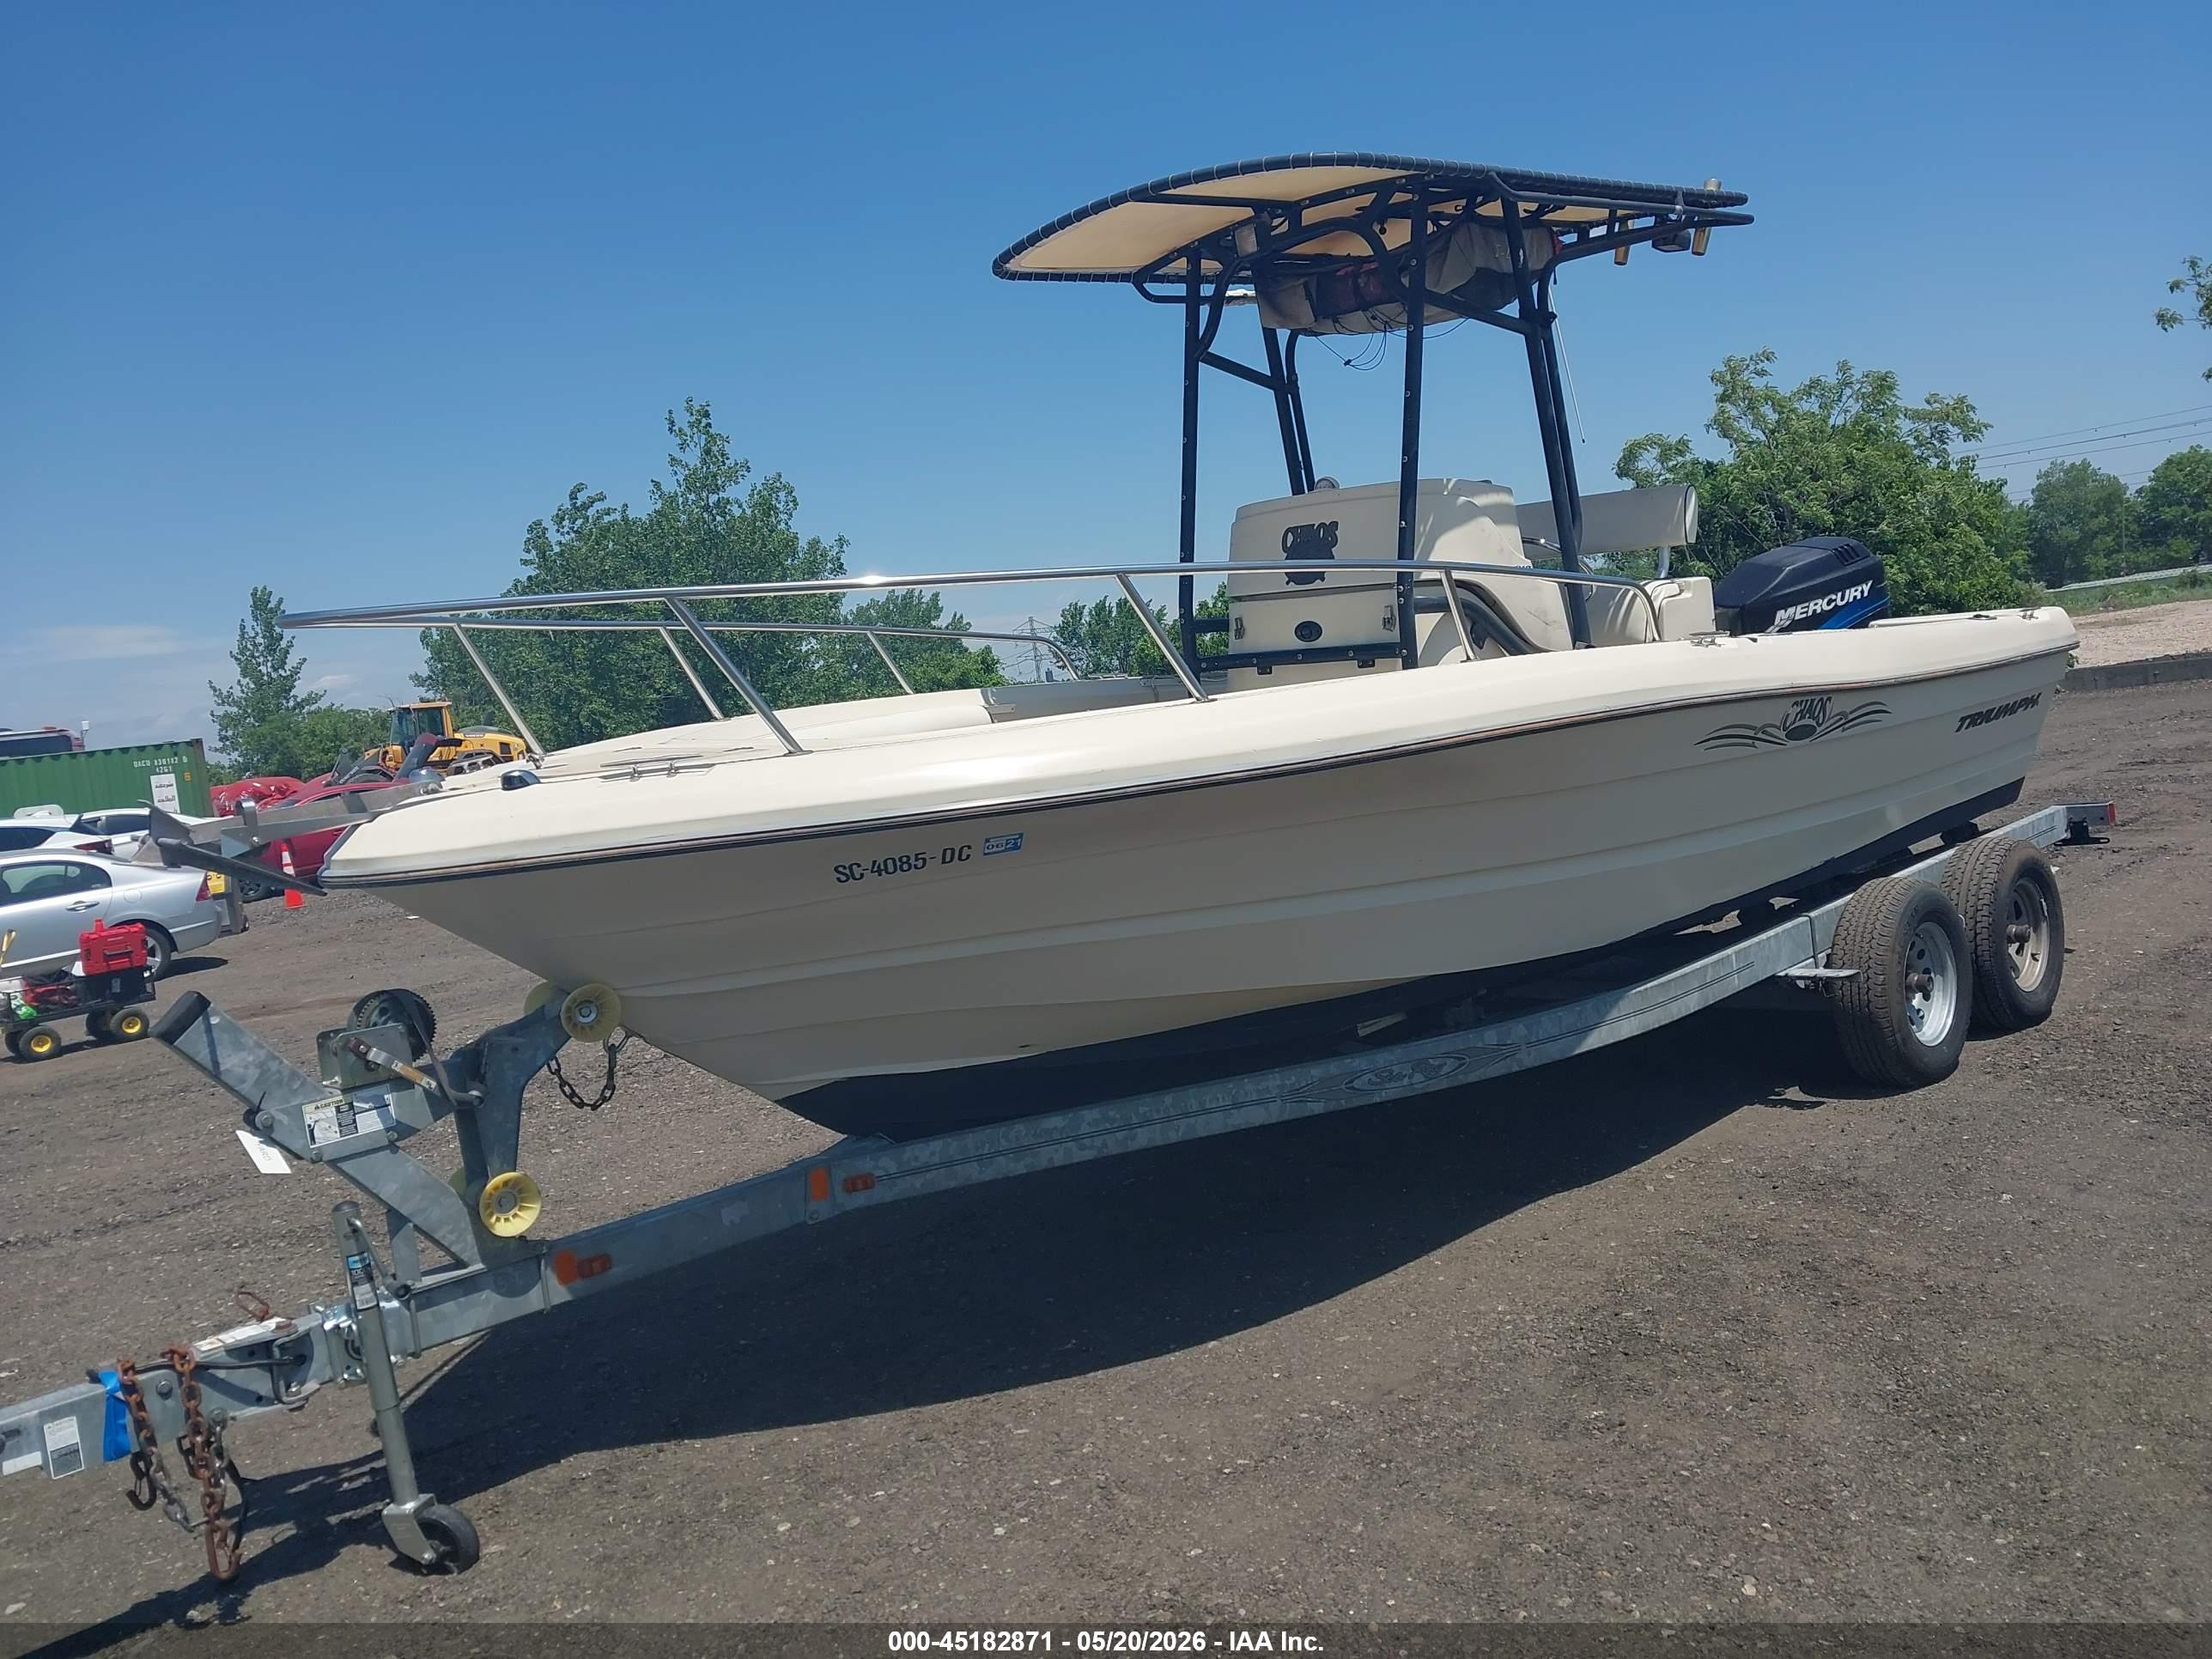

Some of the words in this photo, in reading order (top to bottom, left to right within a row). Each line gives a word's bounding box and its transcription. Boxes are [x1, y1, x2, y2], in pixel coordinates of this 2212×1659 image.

[1769, 580, 1874, 631] MERCURY
[1782, 696, 1832, 730] CHAOS
[1955, 692, 2042, 732] TRIUMPH
[319, 1098, 344, 1109] CAUTION
